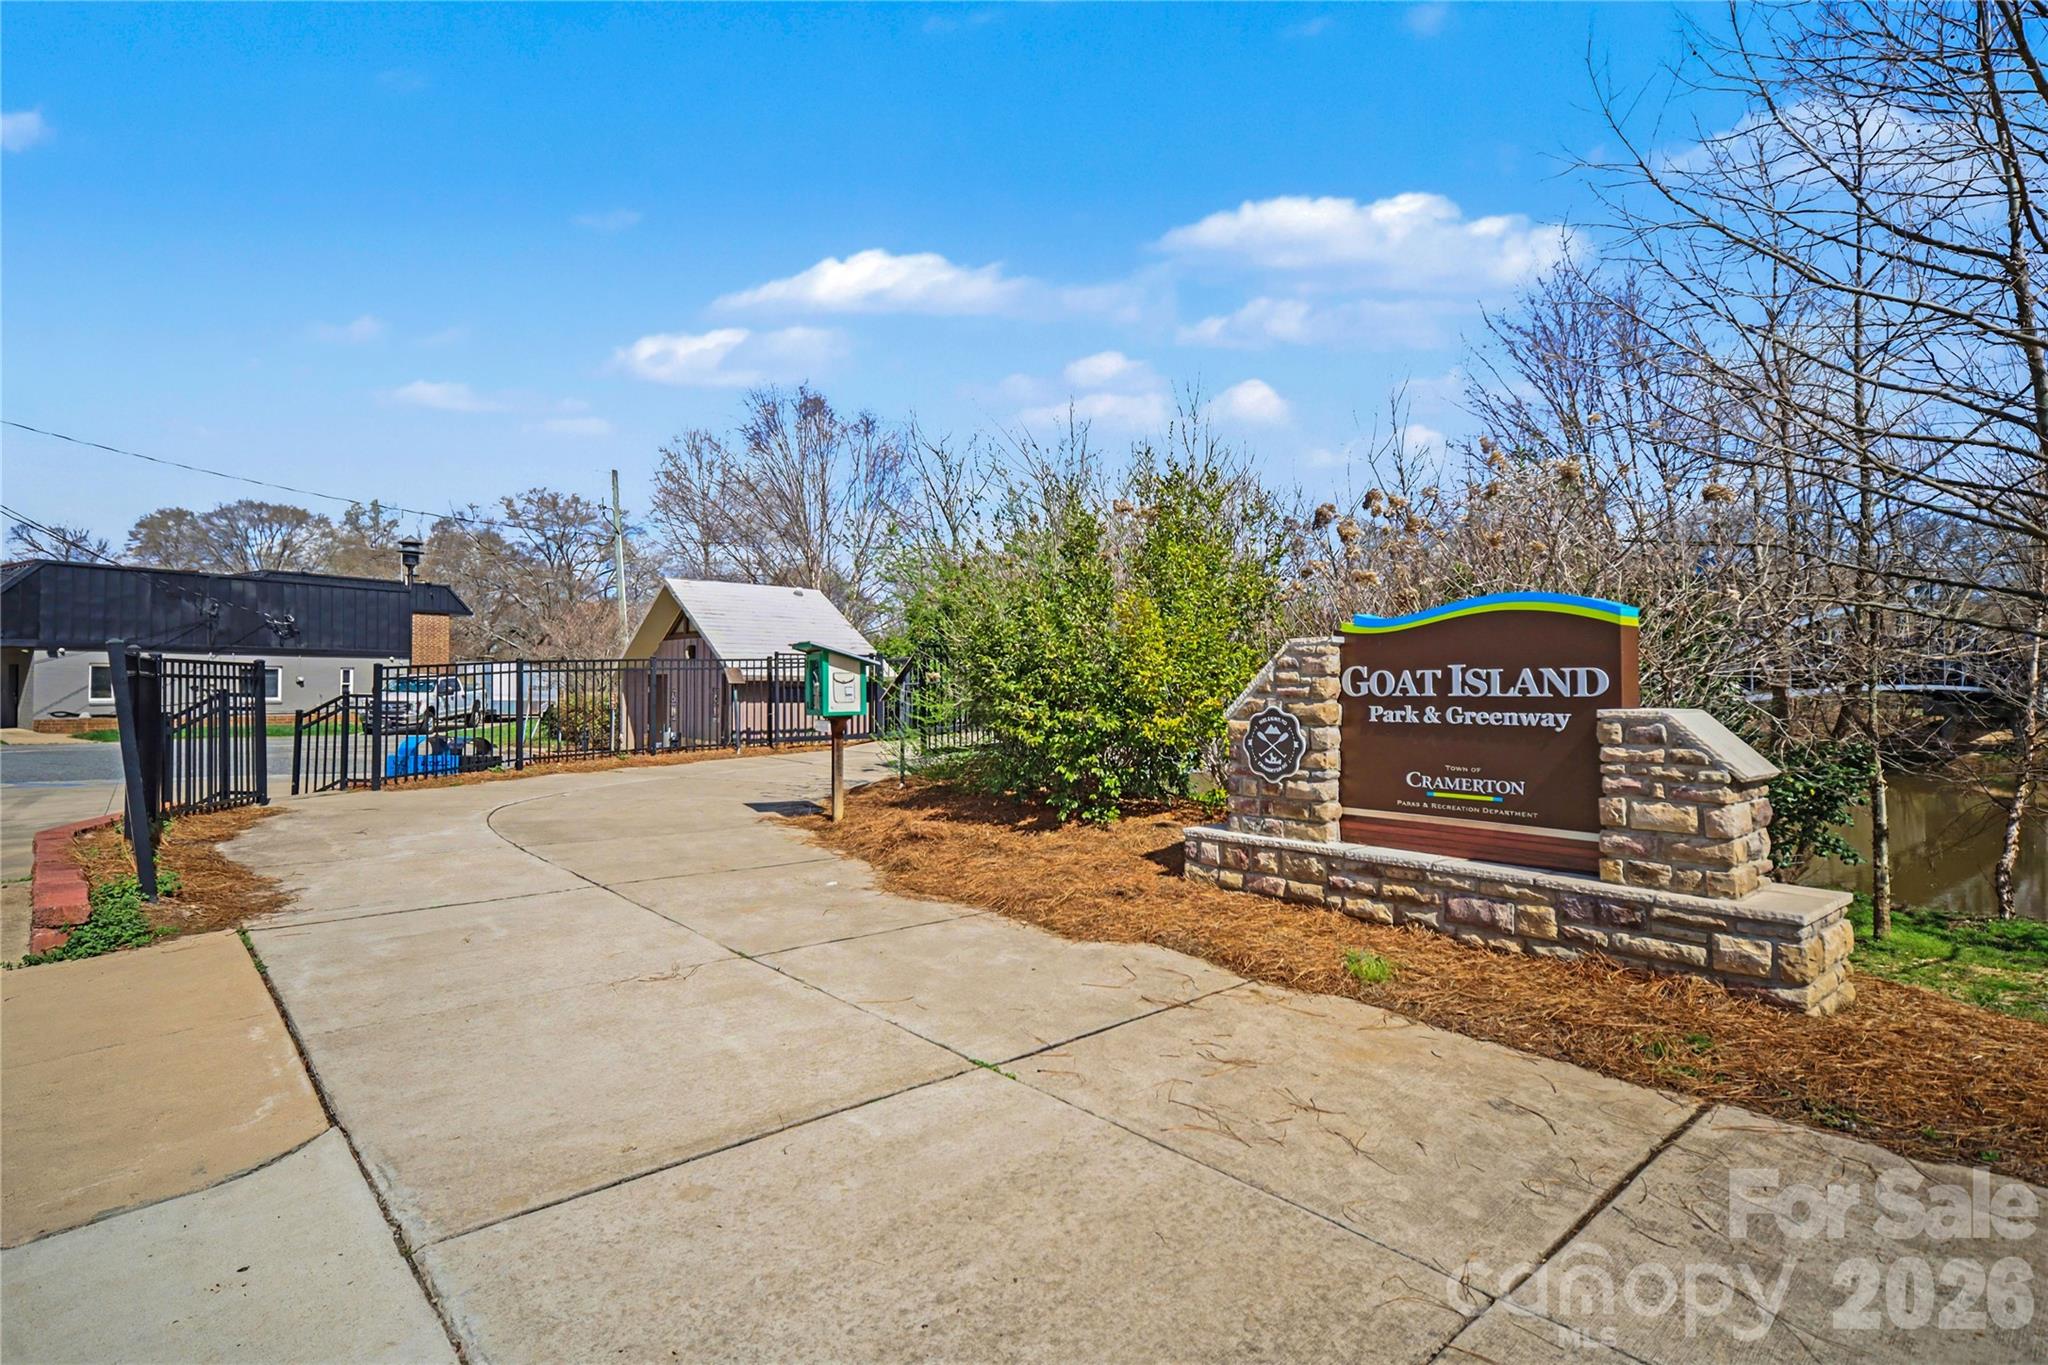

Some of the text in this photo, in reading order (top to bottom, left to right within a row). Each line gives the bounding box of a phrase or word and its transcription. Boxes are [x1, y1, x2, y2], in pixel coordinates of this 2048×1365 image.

[1341, 664, 1609, 699] GOAT ISLAND
[1369, 705, 1571, 733] Park & Greenway
[1445, 764, 1469, 772] TOWN
[1405, 771, 1526, 796] CRAMERTON
[1396, 800, 1420, 808] PARKS
[1431, 803, 1480, 813] RECREATION
[1482, 807, 1538, 819] DEPARTMENT
